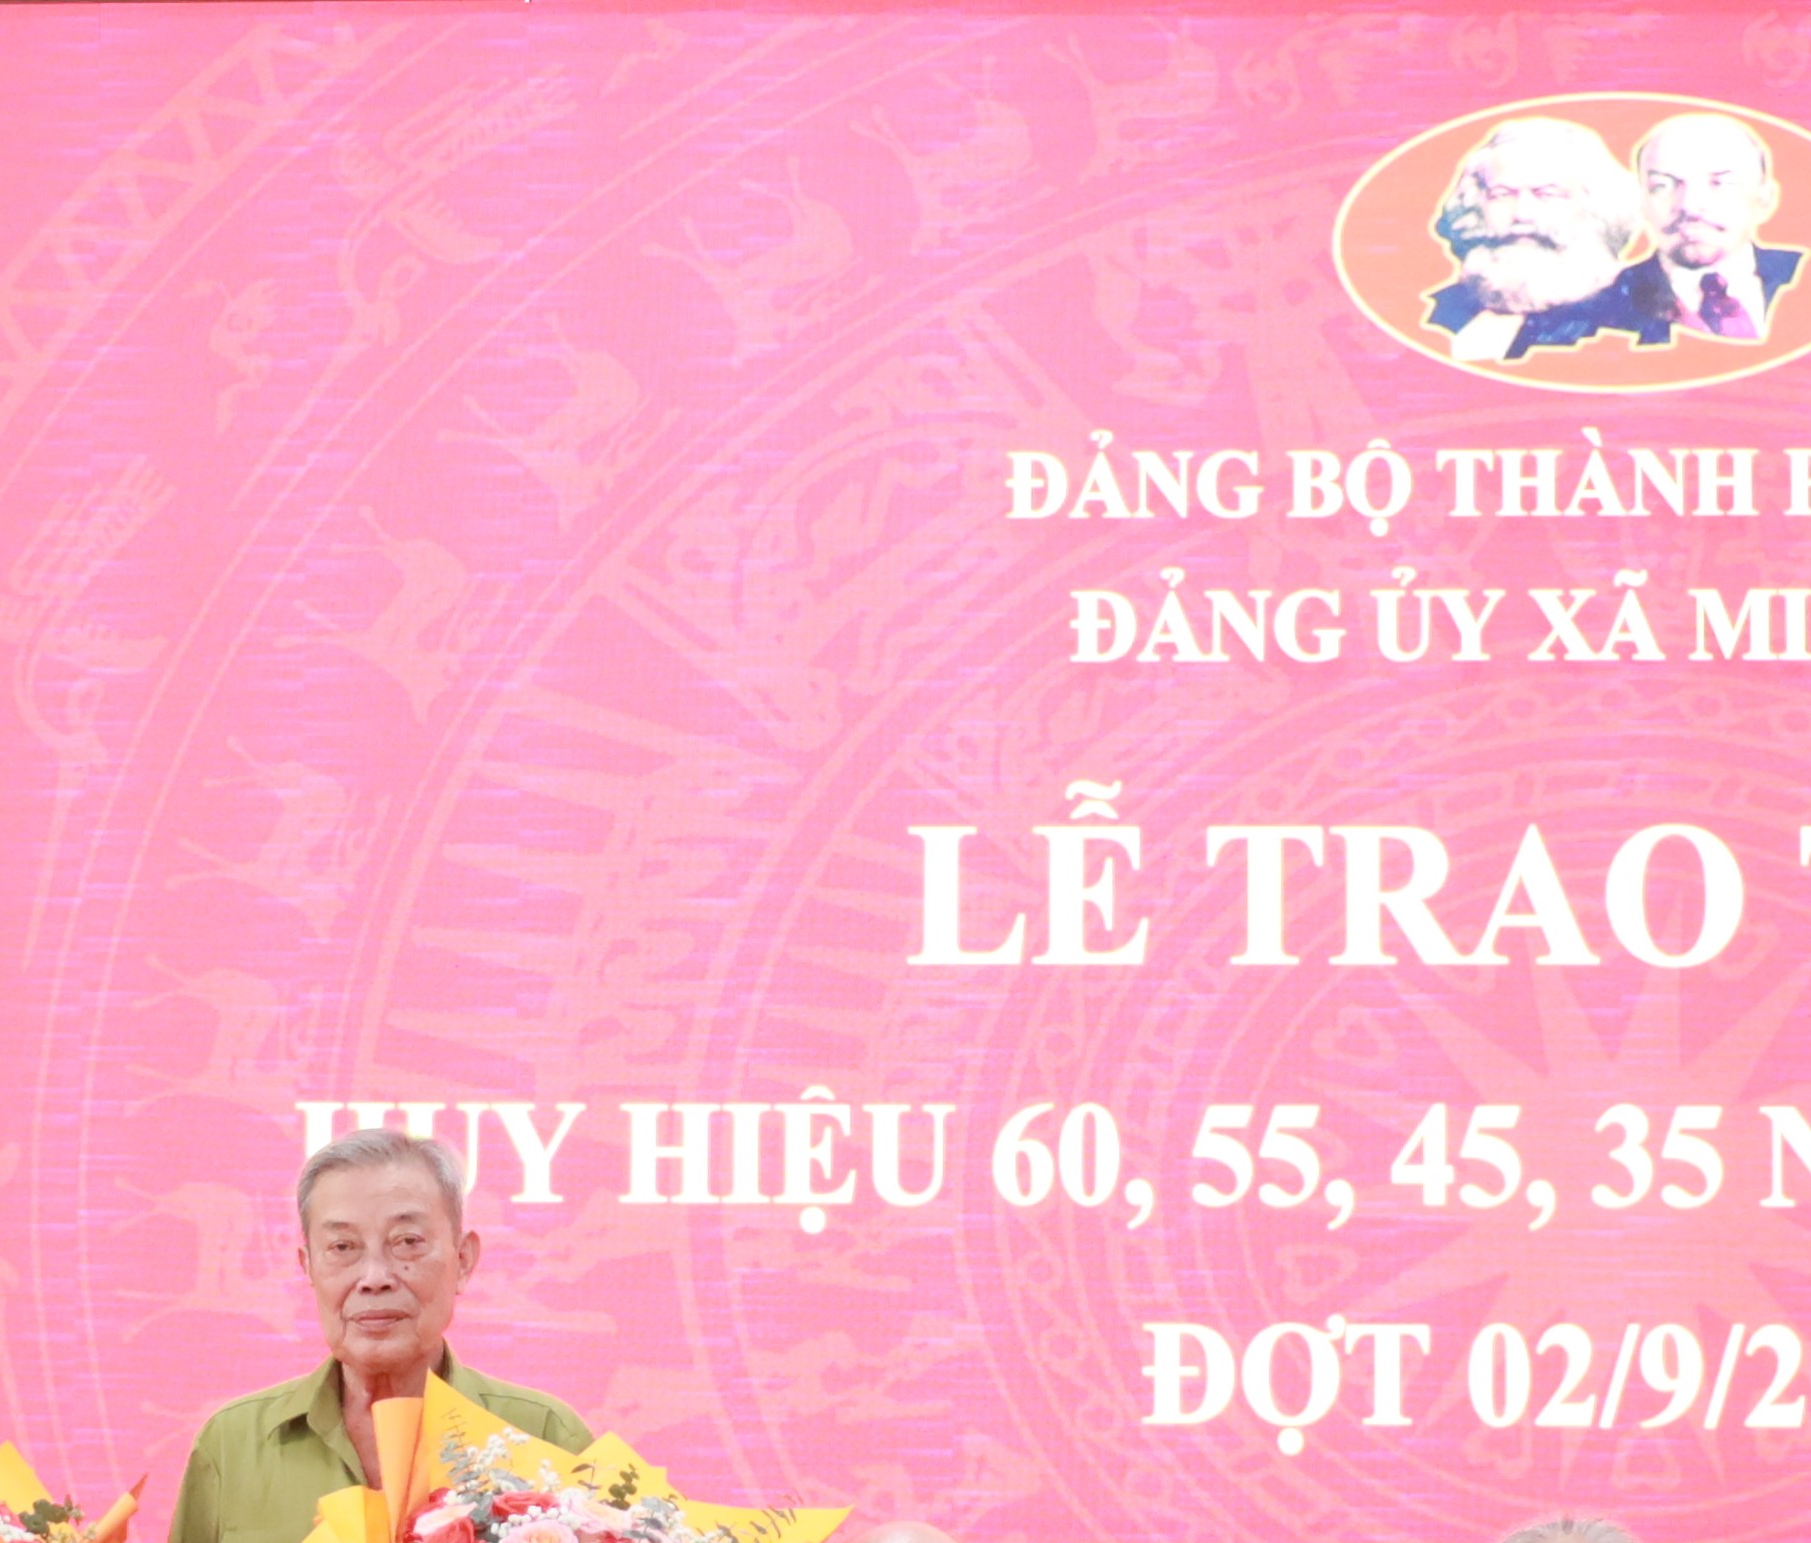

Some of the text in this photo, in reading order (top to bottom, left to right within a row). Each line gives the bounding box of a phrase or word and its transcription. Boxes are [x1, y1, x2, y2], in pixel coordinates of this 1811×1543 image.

[1004, 429, 1262, 519] ĐẢNG
[1286, 437, 1413, 537] BỘ
[1435, 426, 1758, 517] THÀNH
[1069, 566, 1345, 663] ĐẢNG
[1369, 565, 1506, 663] ỦY
[1527, 568, 1666, 662] XÃ
[905, 779, 1150, 967] LỄ
[1205, 823, 1745, 970] TRAO
[618, 1084, 957, 1235] HIỆU
[991, 1101, 1155, 1230] 60,
[1191, 1103, 1356, 1231] 55,
[1390, 1102, 1557, 1231] 45,
[1590, 1102, 1724, 1210] 35
[1141, 1313, 1432, 1456] ĐỢT
